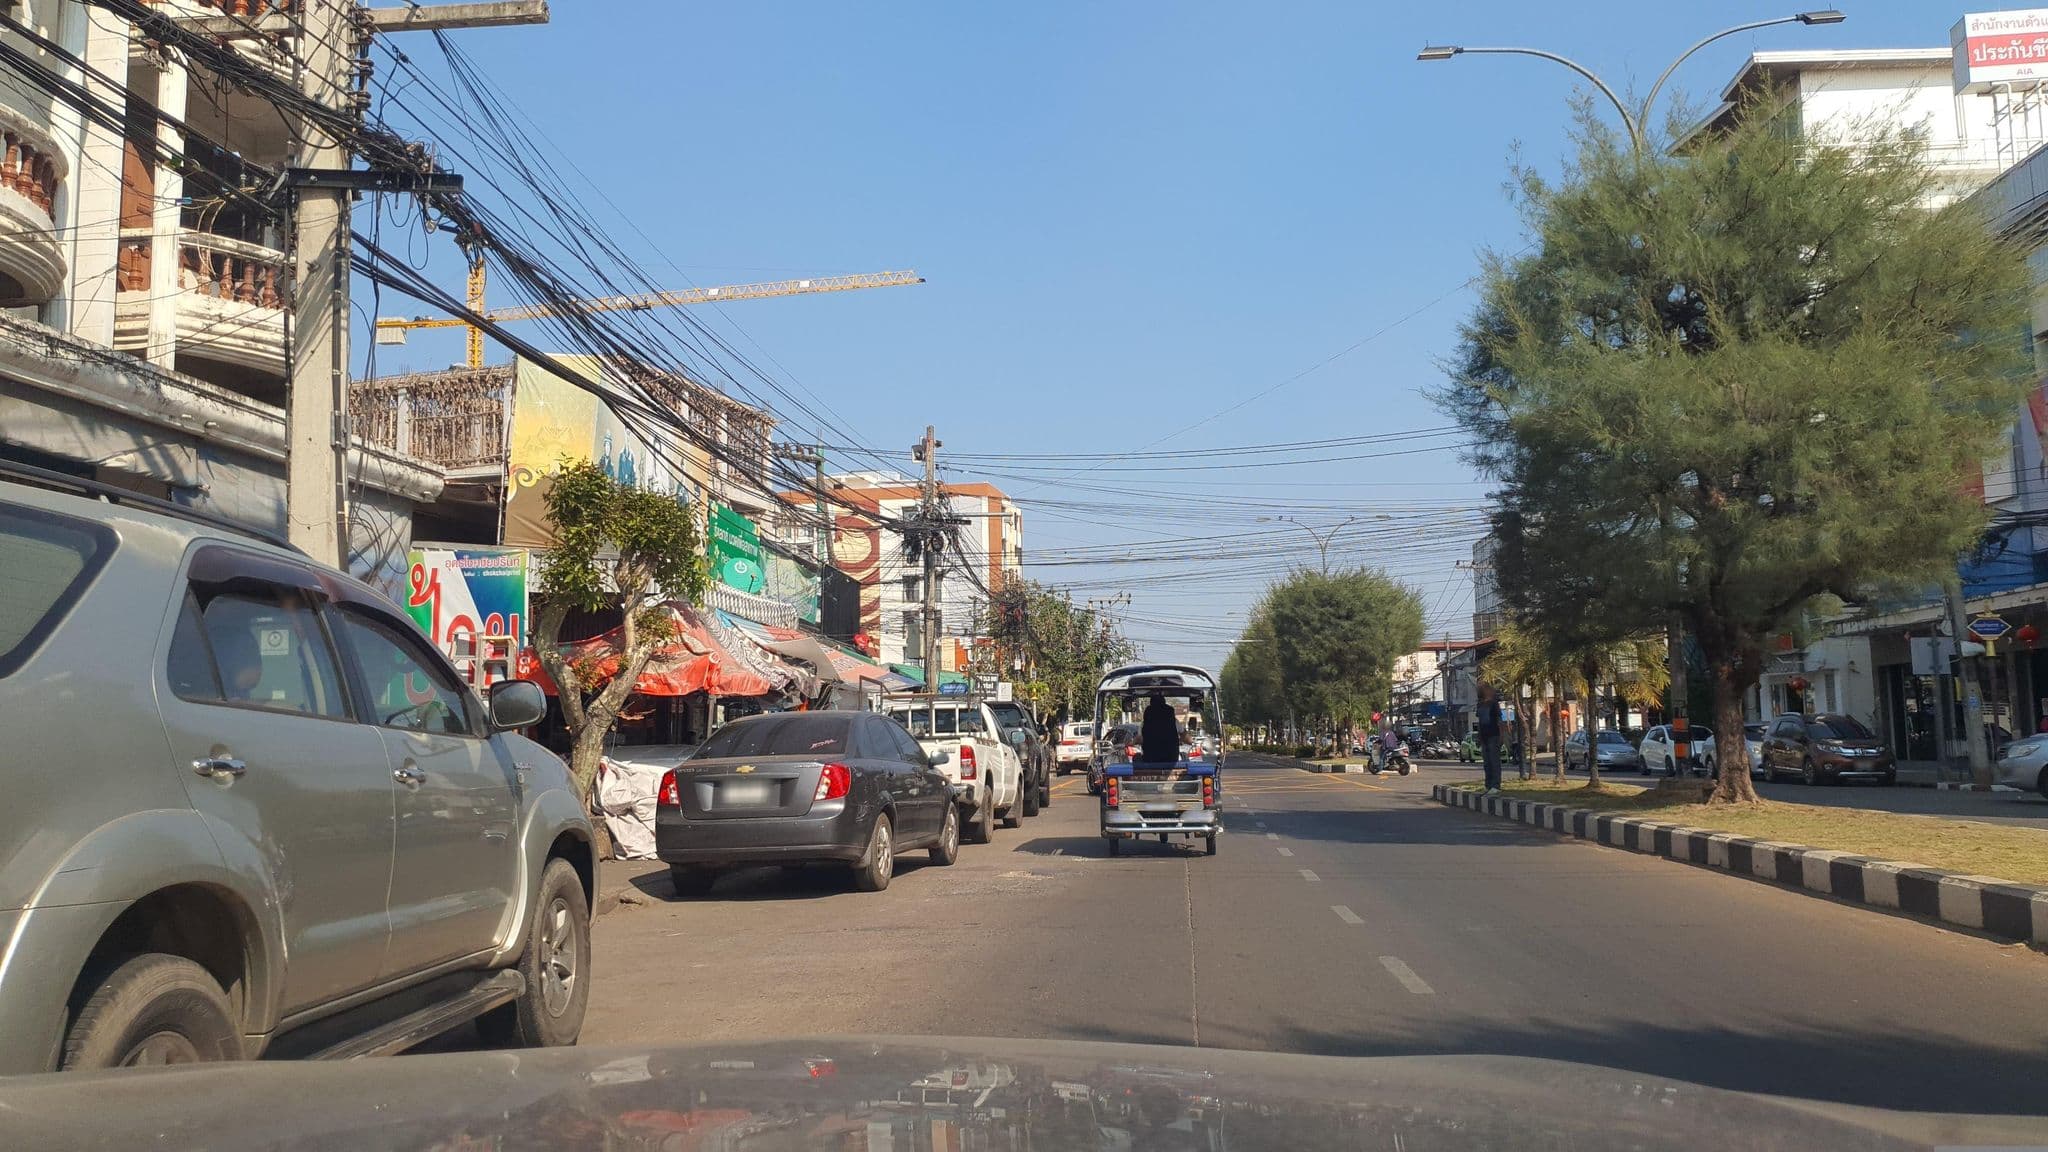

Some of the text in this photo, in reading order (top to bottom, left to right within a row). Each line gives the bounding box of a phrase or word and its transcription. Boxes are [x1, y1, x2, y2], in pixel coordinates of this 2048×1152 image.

[1973, 37, 2048, 62] ประกันชี
[2016, 67, 2034, 75] AIA
